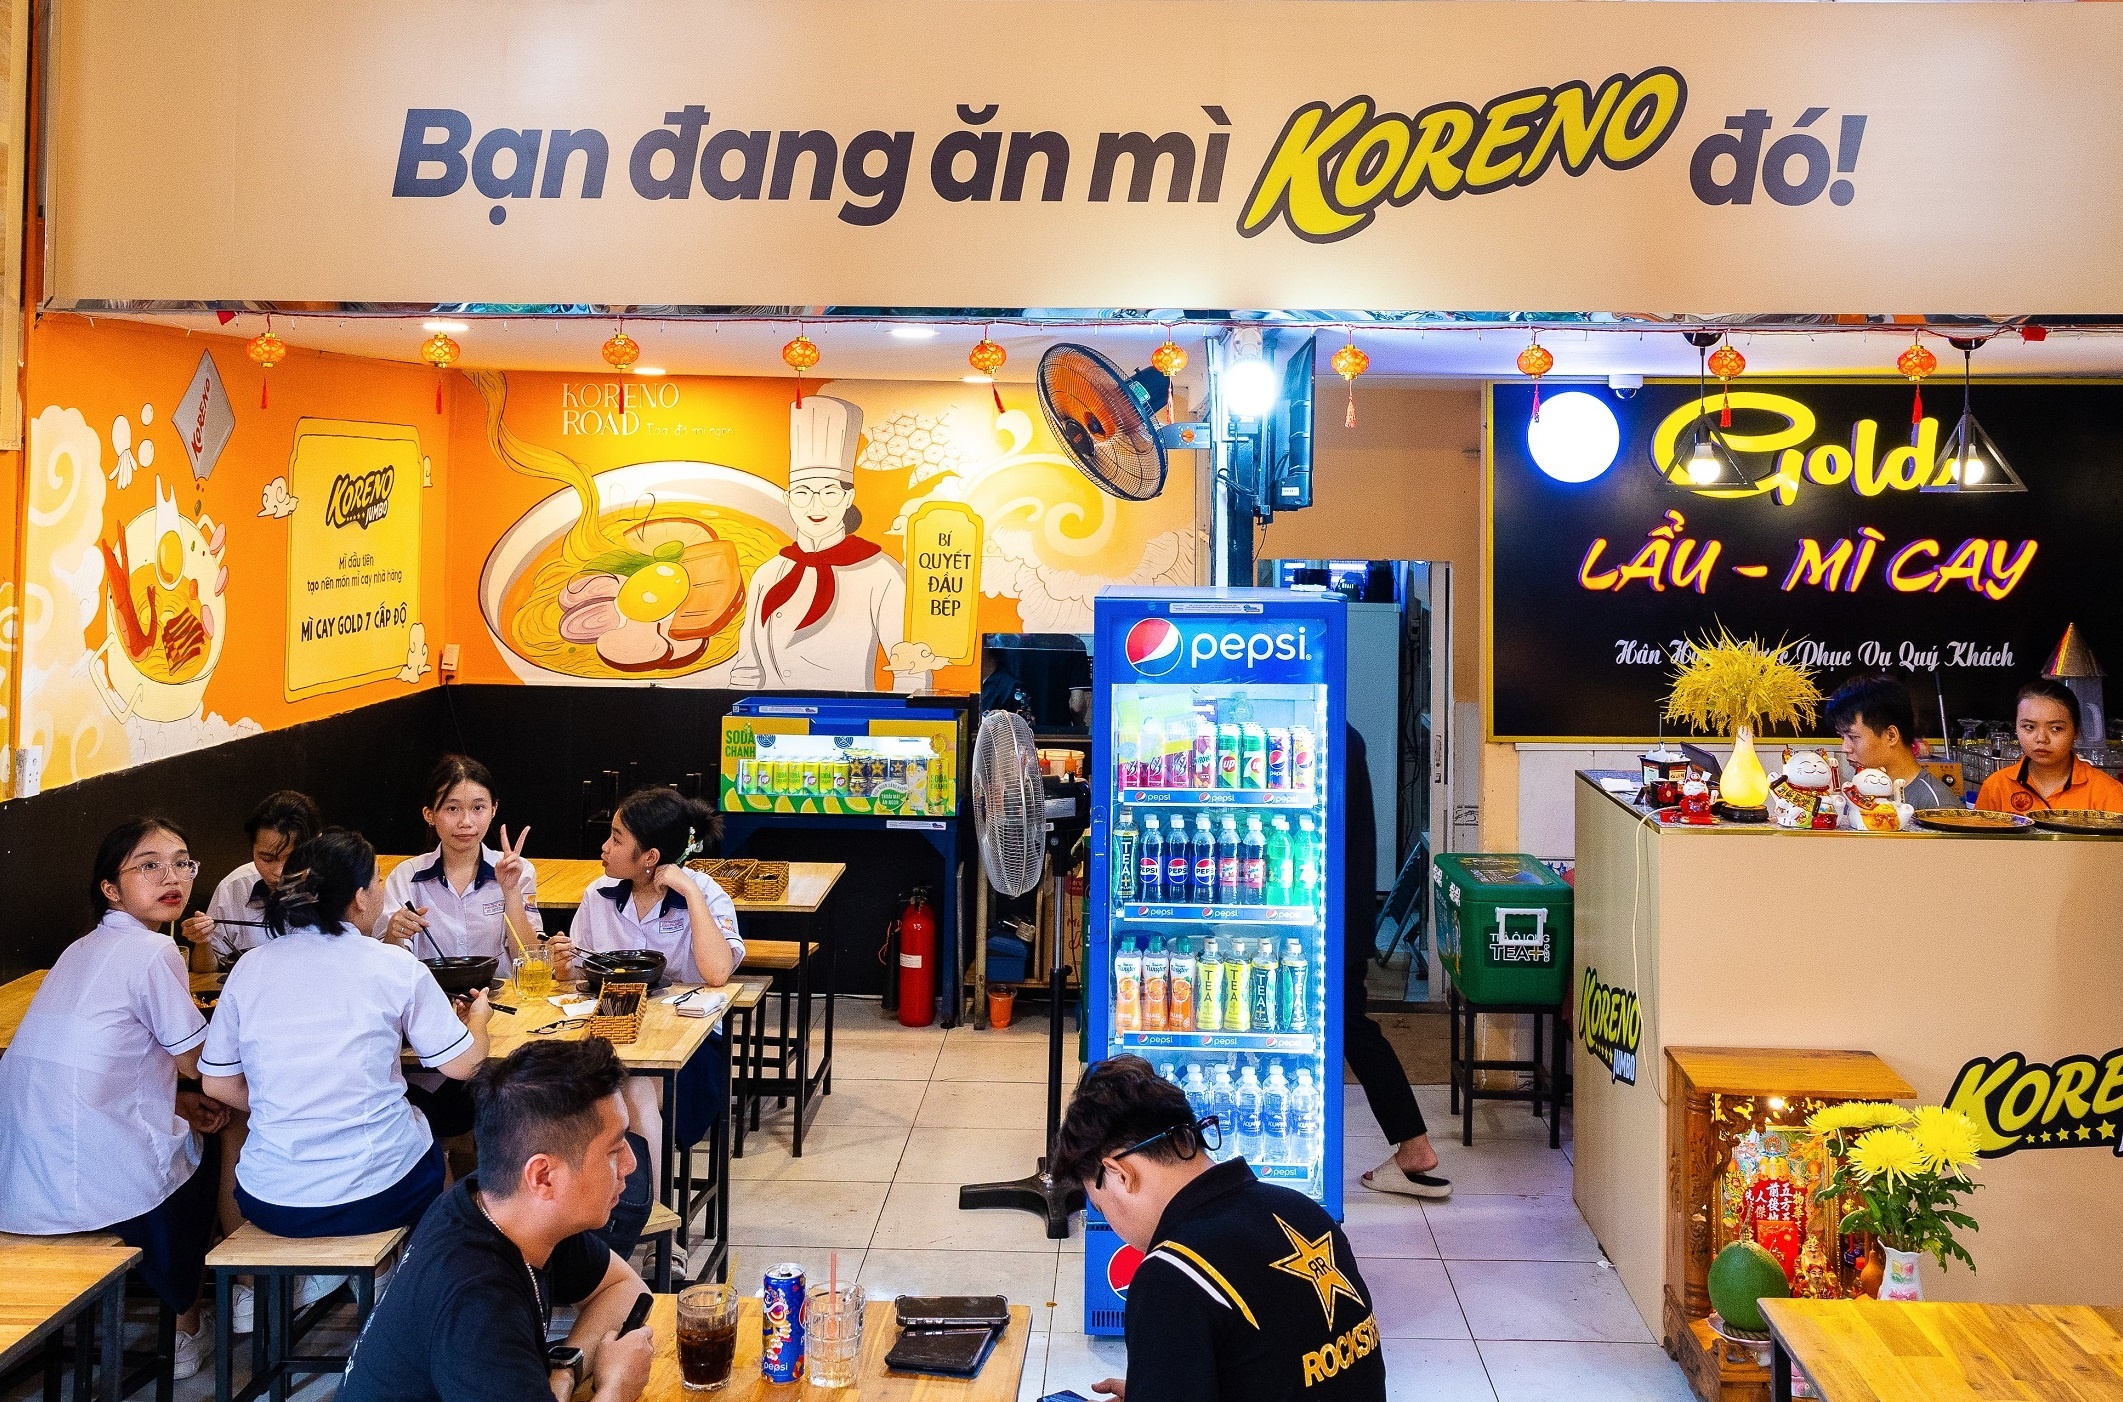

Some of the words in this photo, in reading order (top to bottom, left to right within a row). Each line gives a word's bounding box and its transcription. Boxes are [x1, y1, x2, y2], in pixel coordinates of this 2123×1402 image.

[392, 108, 609, 226] Bạn
[629, 105, 915, 226] đang
[931, 104, 1070, 203] ăn
[1087, 105, 1232, 203] mì
[1238, 68, 1687, 242] KORENO
[1689, 107, 1868, 207] đó!
[562, 383, 680, 409] KORENO
[191, 378, 210, 462] KORENO
[562, 410, 640, 436] ROAD
[1651, 391, 1961, 506] Gold
[325, 465, 395, 529] KORENO
[365, 500, 389, 525] JUMBO
[938, 531, 952, 547] BÍ
[918, 549, 971, 569] QUYẾT
[1578, 509, 1722, 594] LẨU
[1780, 526, 1886, 592] MÌ
[1886, 538, 2038, 599] CAY
[307, 579, 319, 595] tạo
[321, 576, 334, 590] nên
[336, 574, 351, 588] món
[351, 570, 360, 586] mì
[361, 573, 373, 587] cay
[374, 570, 386, 584] nhà
[930, 594, 961, 616] BẾP
[301, 616, 313, 642] MÌ
[315, 617, 336, 639] CAY
[337, 614, 363, 635] GOLD
[365, 611, 372, 630] 7
[374, 601, 391, 628] CẤP
[394, 602, 408, 628] ĐỘ
[1191, 626, 1307, 669] pepsi
[1796, 641, 1851, 671] Phục
[1858, 641, 1893, 672] Vụ
[1899, 641, 1940, 672] Quý
[1944, 641, 2016, 667] Khách
[726, 730, 755, 744] SODA
[725, 745, 756, 758] CHANH
[1148, 793, 1171, 802] pepsi
[1212, 794, 1235, 803] pepsi
[1151, 908, 1174, 917] pepsi
[1215, 909, 1238, 918] pepsi
[1579, 966, 1641, 1054] KORENO
[1149, 1036, 1173, 1045] pepsi
[1214, 1037, 1237, 1046] pepsi
[1612, 1048, 1635, 1082] JUMBO
[1274, 1168, 1297, 1177] pepsi
[764, 1362, 788, 1373] pepsi
